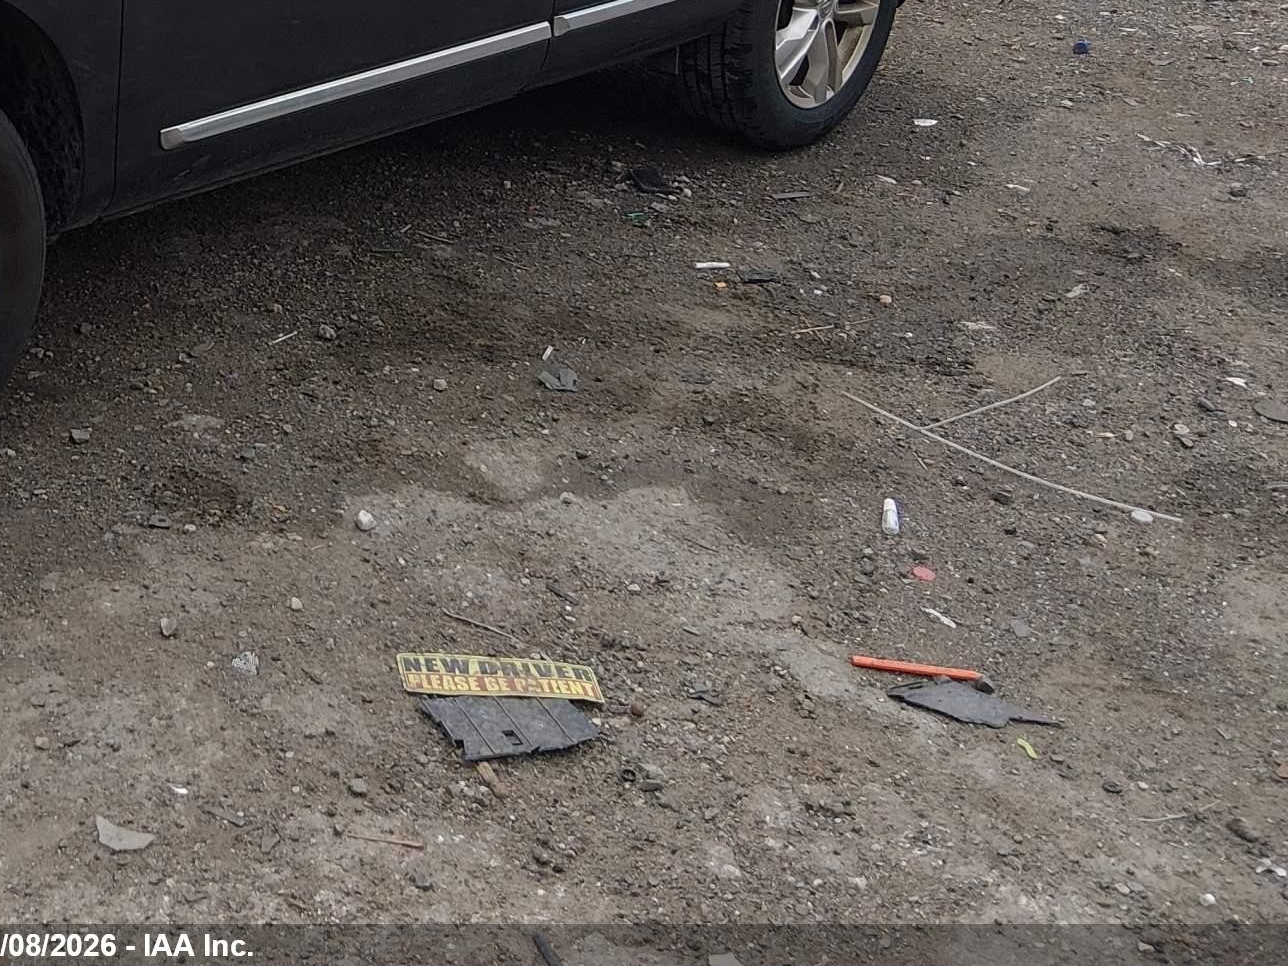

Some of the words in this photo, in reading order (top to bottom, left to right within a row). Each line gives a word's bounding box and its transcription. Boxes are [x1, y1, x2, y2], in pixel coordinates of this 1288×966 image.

[403, 656, 470, 675] NEW
[478, 659, 594, 682] DRIVER
[407, 673, 481, 692] PLEASE
[484, 676, 512, 692] BE
